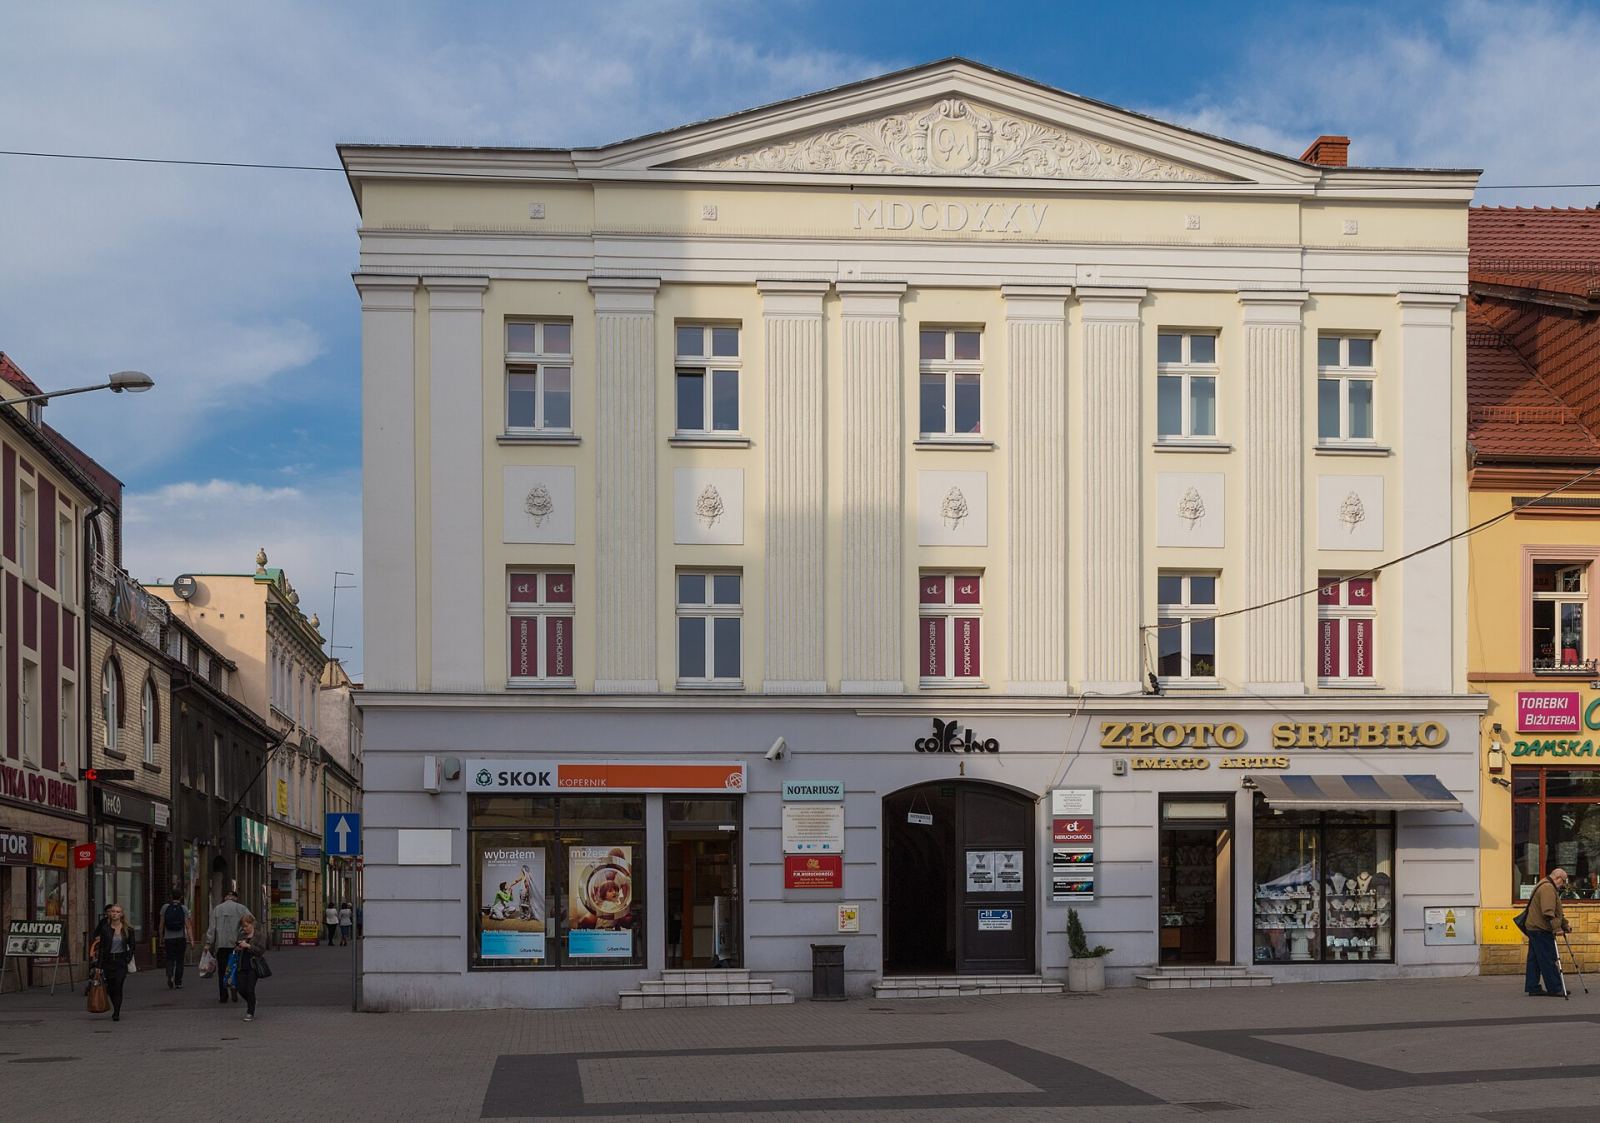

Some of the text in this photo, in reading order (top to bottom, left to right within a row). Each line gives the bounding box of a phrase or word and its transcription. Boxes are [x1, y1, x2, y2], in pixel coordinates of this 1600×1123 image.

[851, 200, 1049, 233] MDCDXXV
[518, 583, 529, 593] et
[553, 583, 564, 593] et
[927, 584, 937, 594] et
[961, 584, 972, 594] et
[1354, 587, 1365, 597] et
[1521, 697, 1569, 709] TOREBKI
[1525, 714, 1577, 726] BIŻUTERIA
[1100, 721, 1447, 749] ZŁOTO SREBRO
[1511, 739, 1593, 757] DAMSKA
[959, 760, 965, 776] 1
[1131, 757, 1210, 770] IMAGO
[1219, 755, 1290, 768] ARTIS
[498, 771, 607, 787] SKOK KOPERNIK
[29, 772, 46, 803] DO
[48, 778, 77, 811] BRAM
[787, 785, 840, 795] NOTARIUSZ
[1067, 820, 1080, 832] et
[0, 833, 28, 855] TOR
[484, 849, 536, 861] wybrałem
[10, 922, 62, 934] KANTOR
